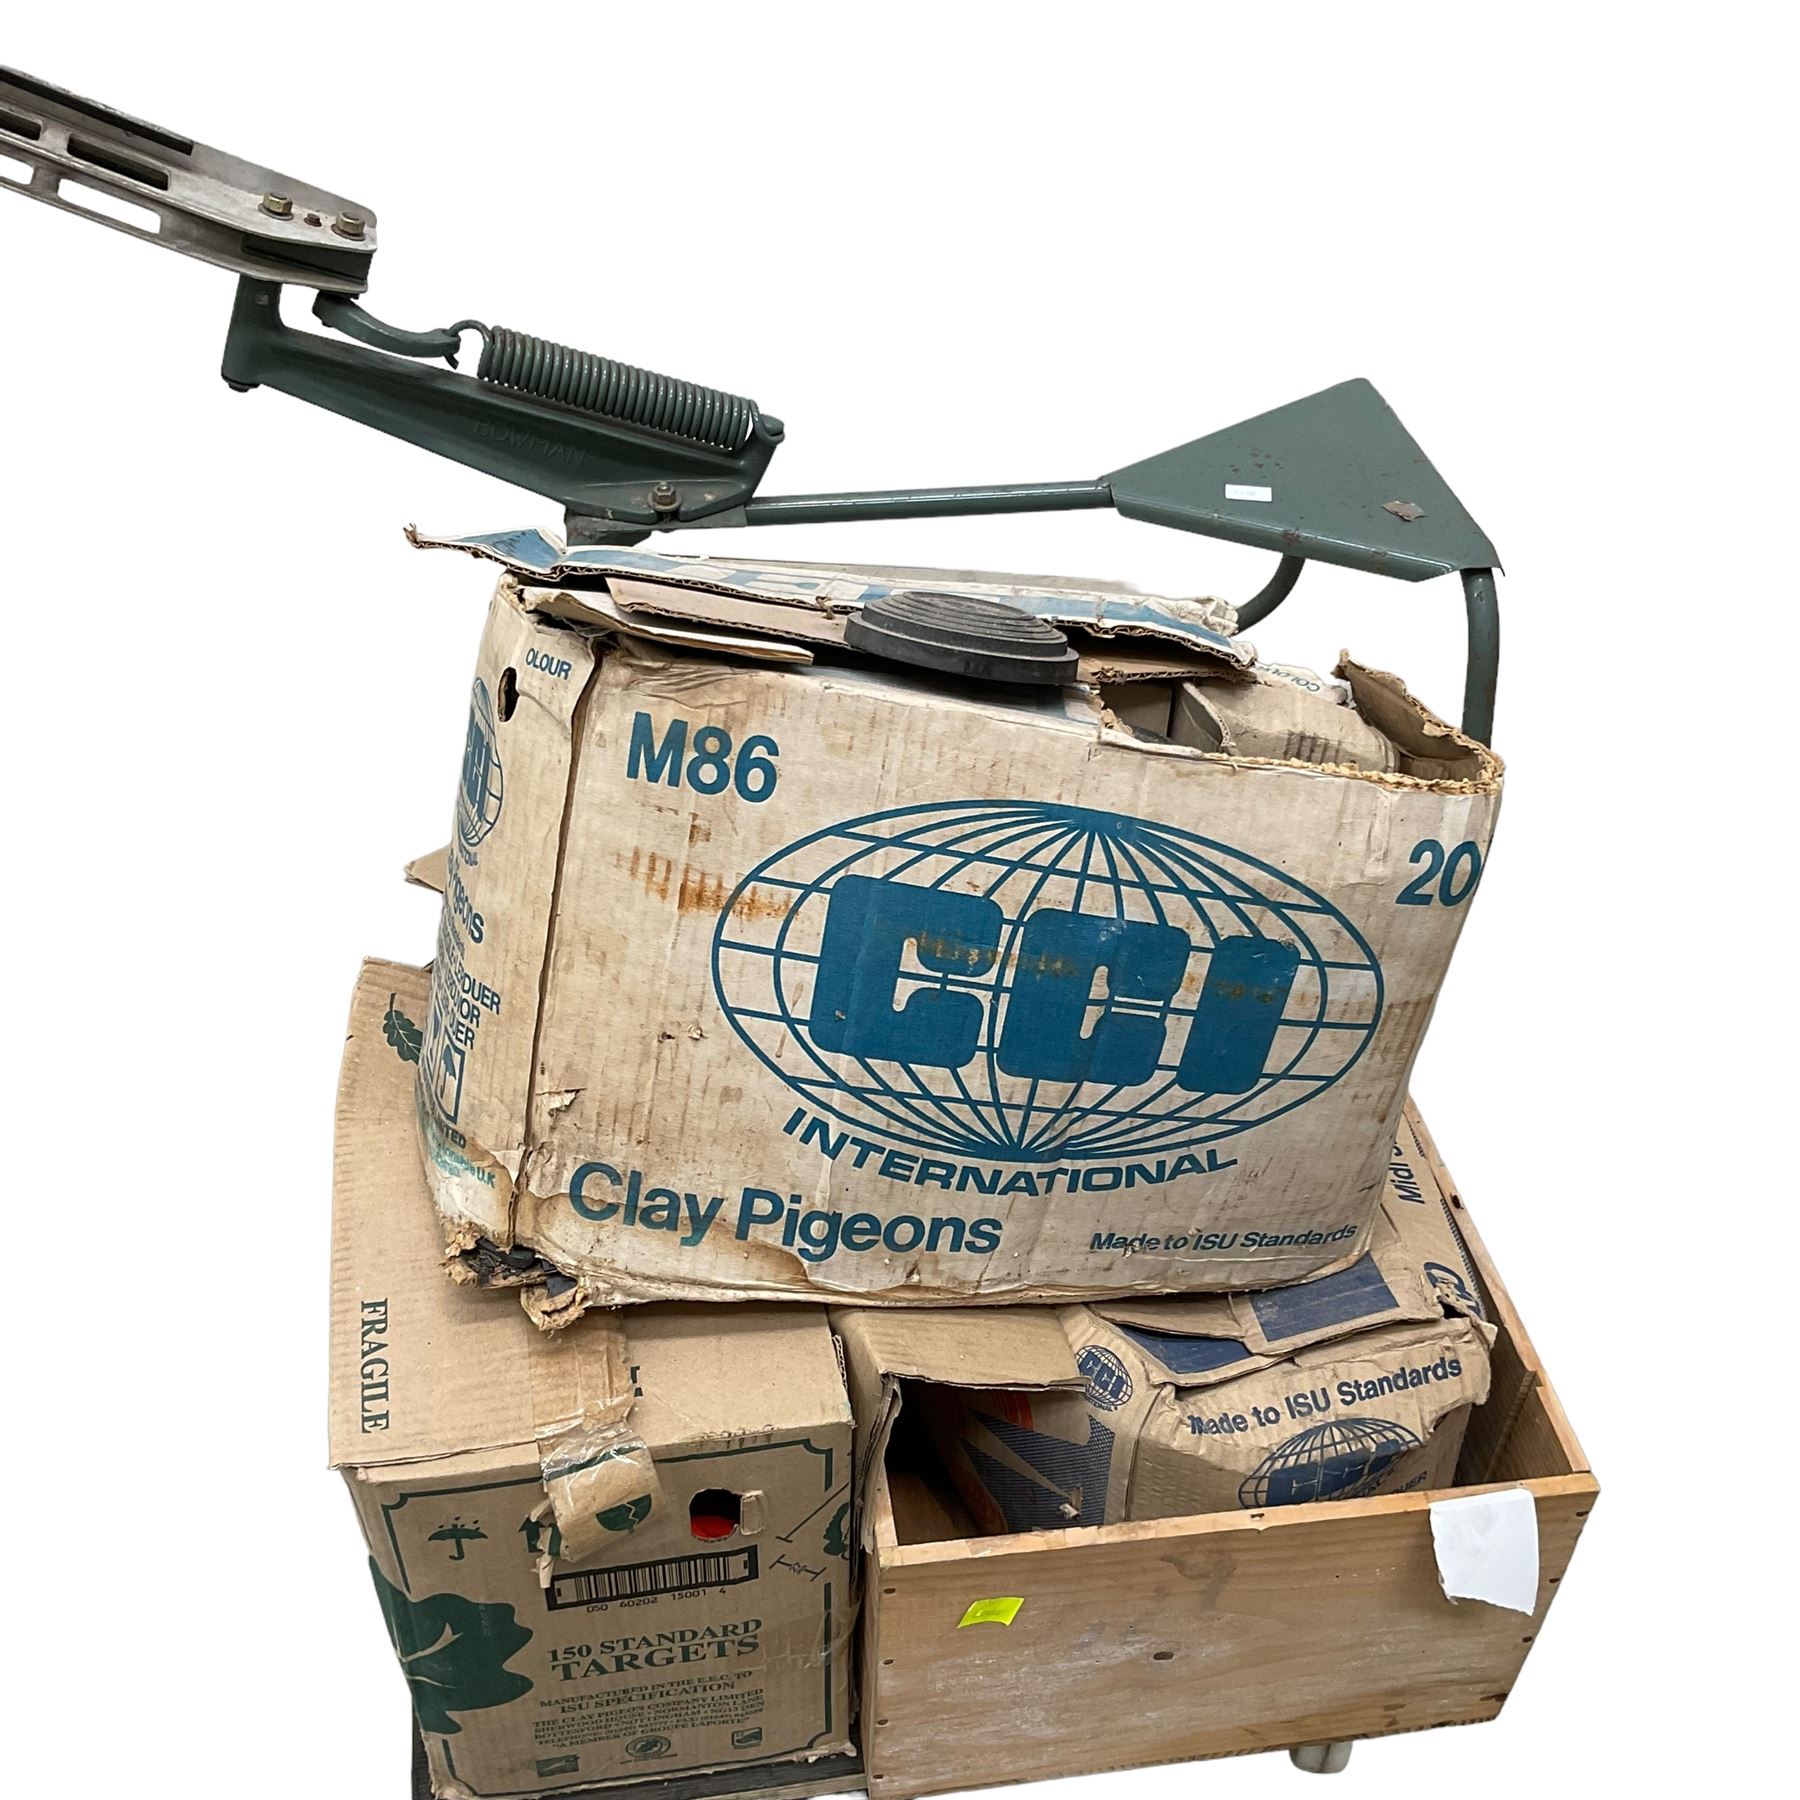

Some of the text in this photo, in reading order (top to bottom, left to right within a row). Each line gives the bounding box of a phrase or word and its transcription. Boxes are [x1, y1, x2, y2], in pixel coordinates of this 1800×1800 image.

[474, 420, 587, 467] BOWMAN
[526, 648, 572, 680] OLOUR
[626, 711, 780, 803] M86
[1395, 838, 1482, 907] 20
[808, 874, 1301, 1094] CCI
[783, 1106, 1238, 1196] INTERNATIONAL
[569, 1160, 1003, 1263] Clay Pigeons
[1090, 1223, 1358, 1252] Made to ISU Standards
[360, 1298, 390, 1434] FRAGILE
[1187, 1356, 1463, 1436] Made to ISU Standards
[586, 1586, 726, 1614] 050 60202 15001 4
[548, 1618, 763, 1662] 150 STANDARD
[552, 1634, 760, 1682] TARGETS
[533, 1688, 763, 1728] THE CLAY PIGEON COMPANY LIMITED
[540, 1685, 648, 1707] MANUFACTURED
[651, 1683, 665, 1691] IN
[667, 1679, 693, 1688] THE
[734, 1670, 753, 1680] TO
[560, 1681, 735, 1714] ISU SPECIFICATION
[732, 1695, 763, 1706] LANE
[569, 1734, 620, 1746] MEMBER
[640, 1721, 689, 1734] GROUPE
[622, 1707, 701, 1726] NOTTINGHAM
